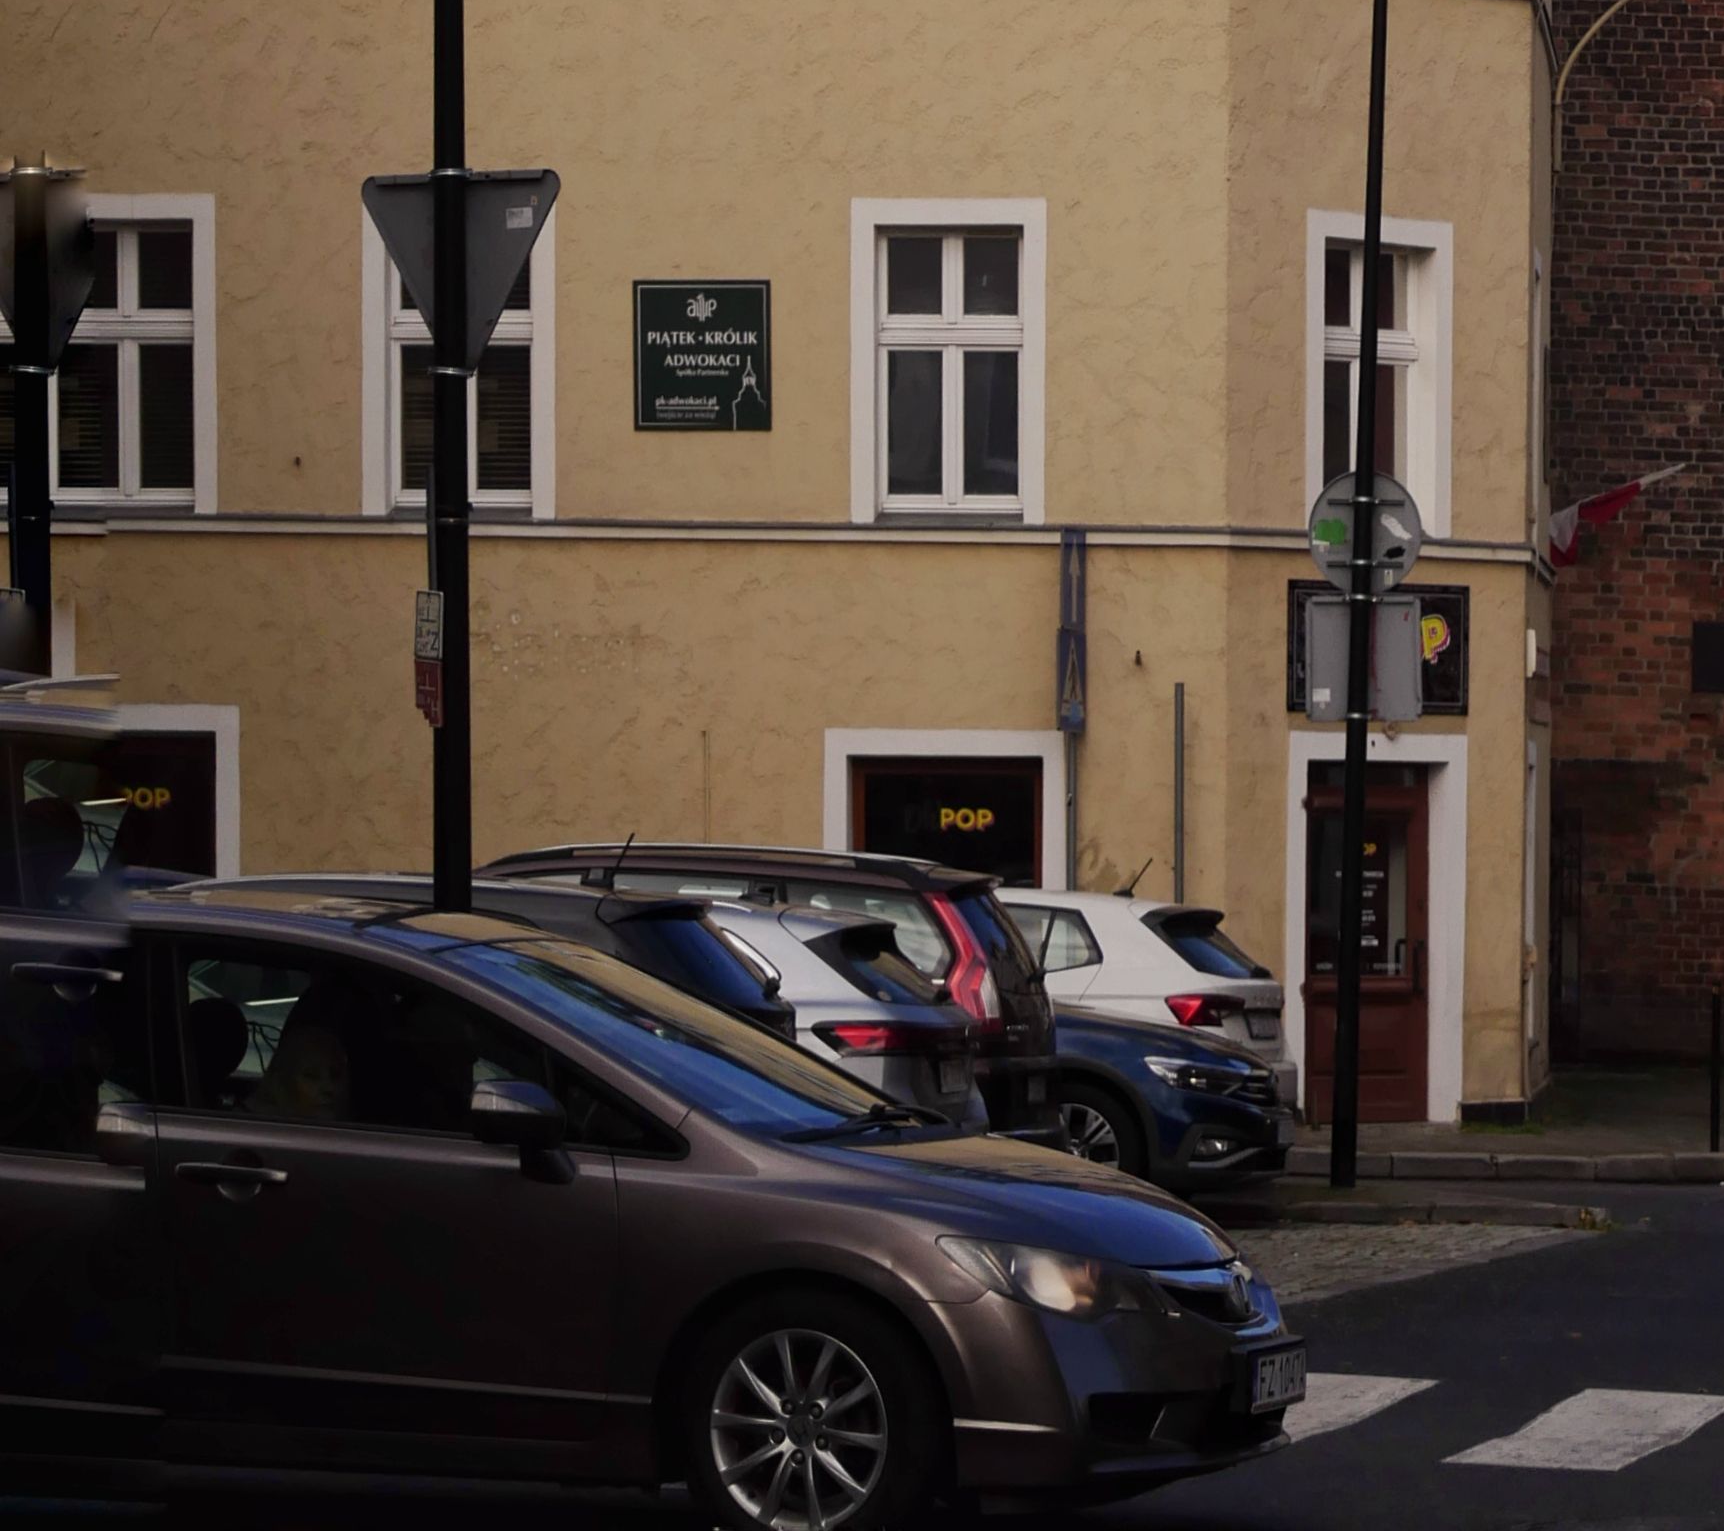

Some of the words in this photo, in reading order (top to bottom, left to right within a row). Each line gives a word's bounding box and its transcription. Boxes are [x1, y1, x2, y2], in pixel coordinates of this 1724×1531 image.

[647, 330, 697, 348] PIĄTEK
[704, 327, 759, 345] KRÓLIK
[663, 354, 741, 367] ADWOKACI
[940, 806, 995, 833] POP
